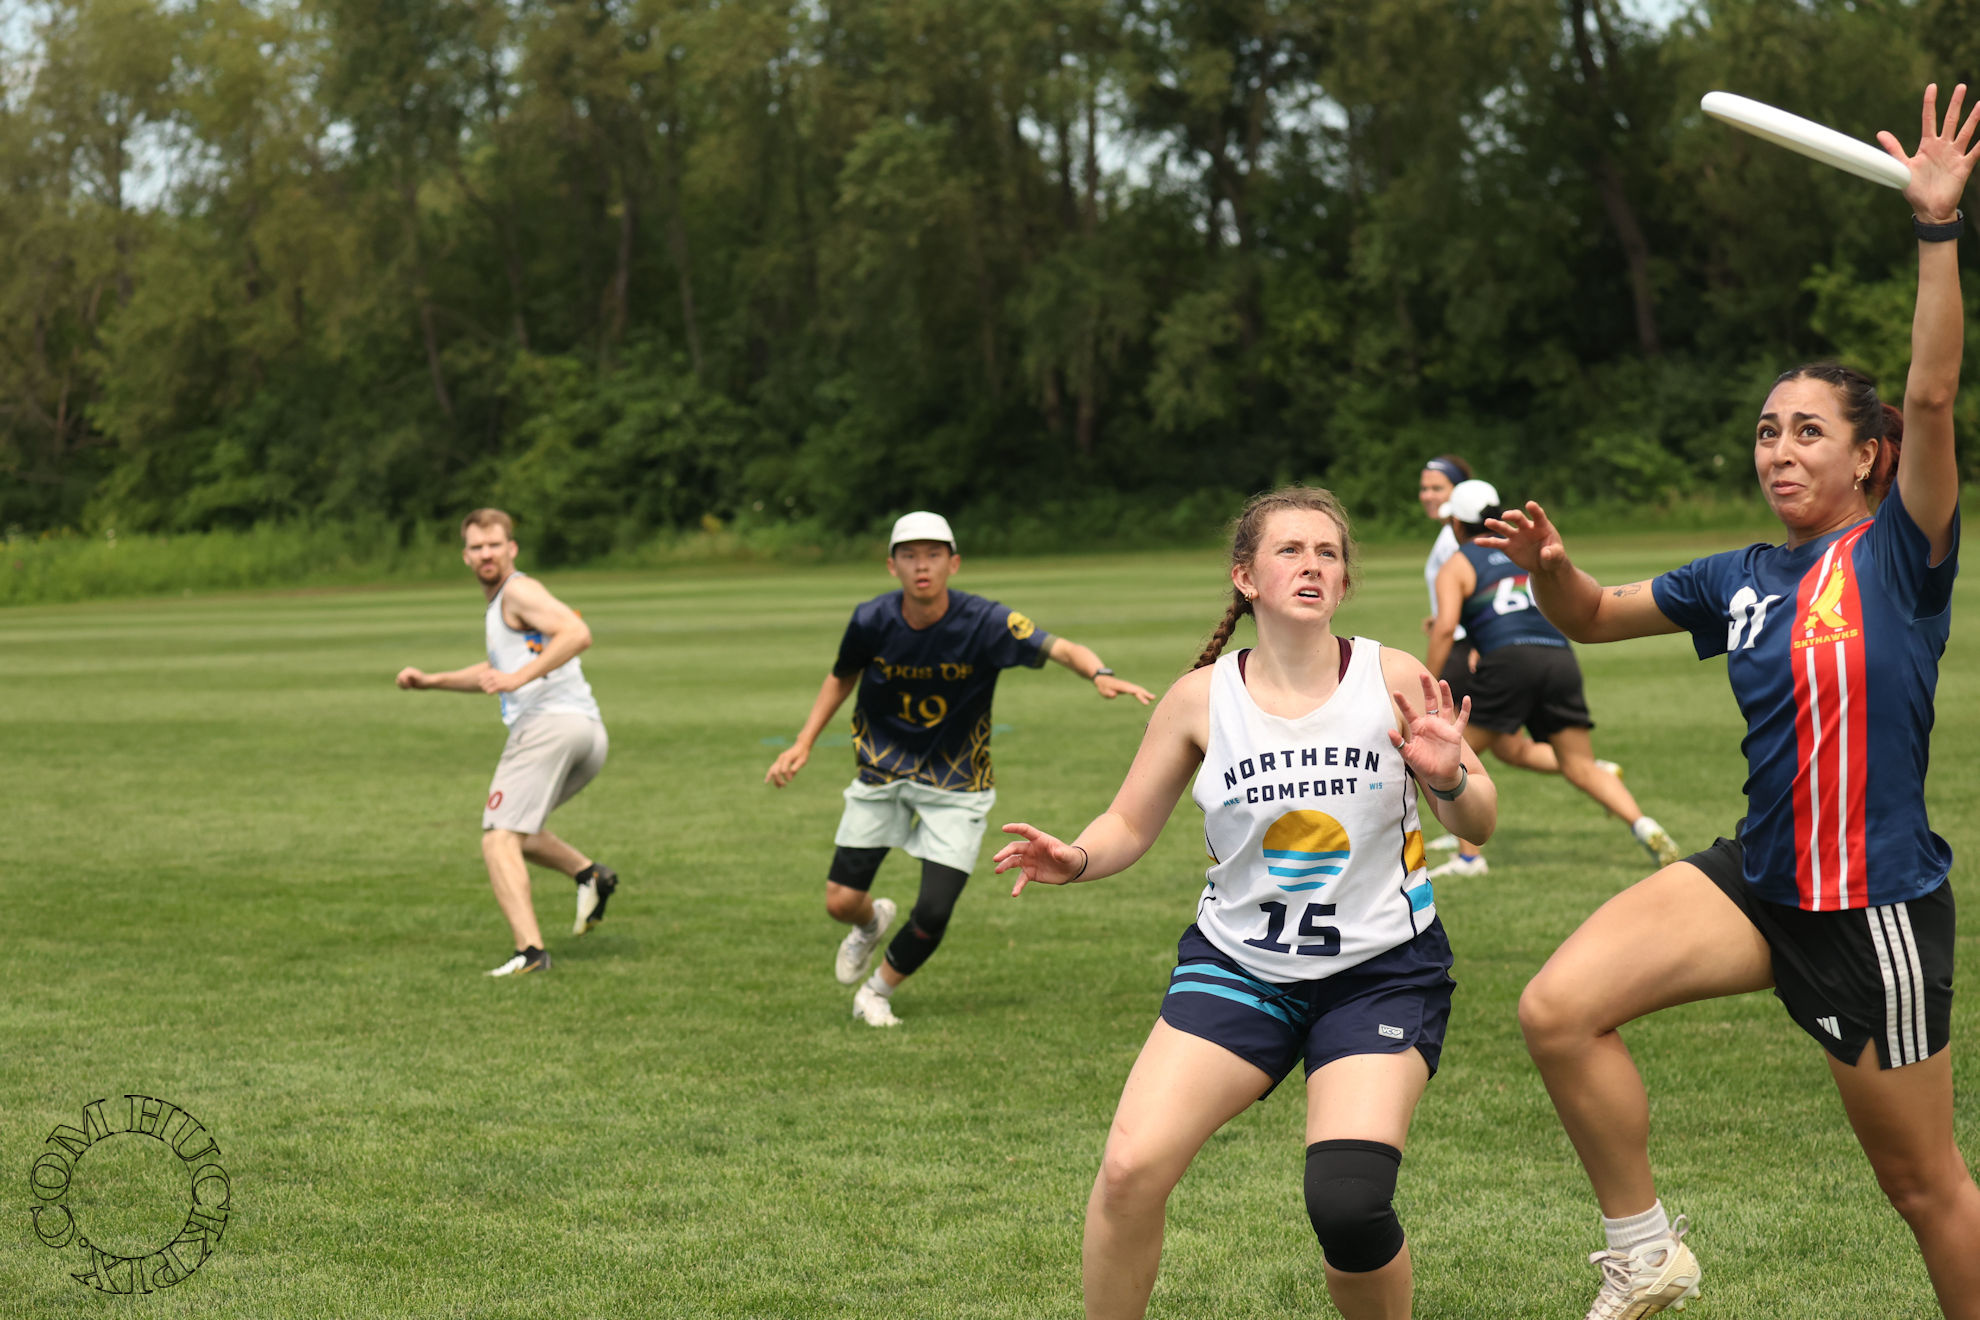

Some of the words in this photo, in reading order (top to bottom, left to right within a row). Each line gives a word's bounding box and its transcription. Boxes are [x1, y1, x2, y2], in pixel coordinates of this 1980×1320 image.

[1793, 628, 1859, 649] SKYHAWKS
[897, 691, 949, 729] 19
[1223, 746, 1380, 791] NORTHERN
[1246, 777, 1358, 804] COMFORT
[1369, 781, 1383, 791] WIS
[1223, 797, 1241, 808] MKE
[1242, 900, 1342, 957] 15
